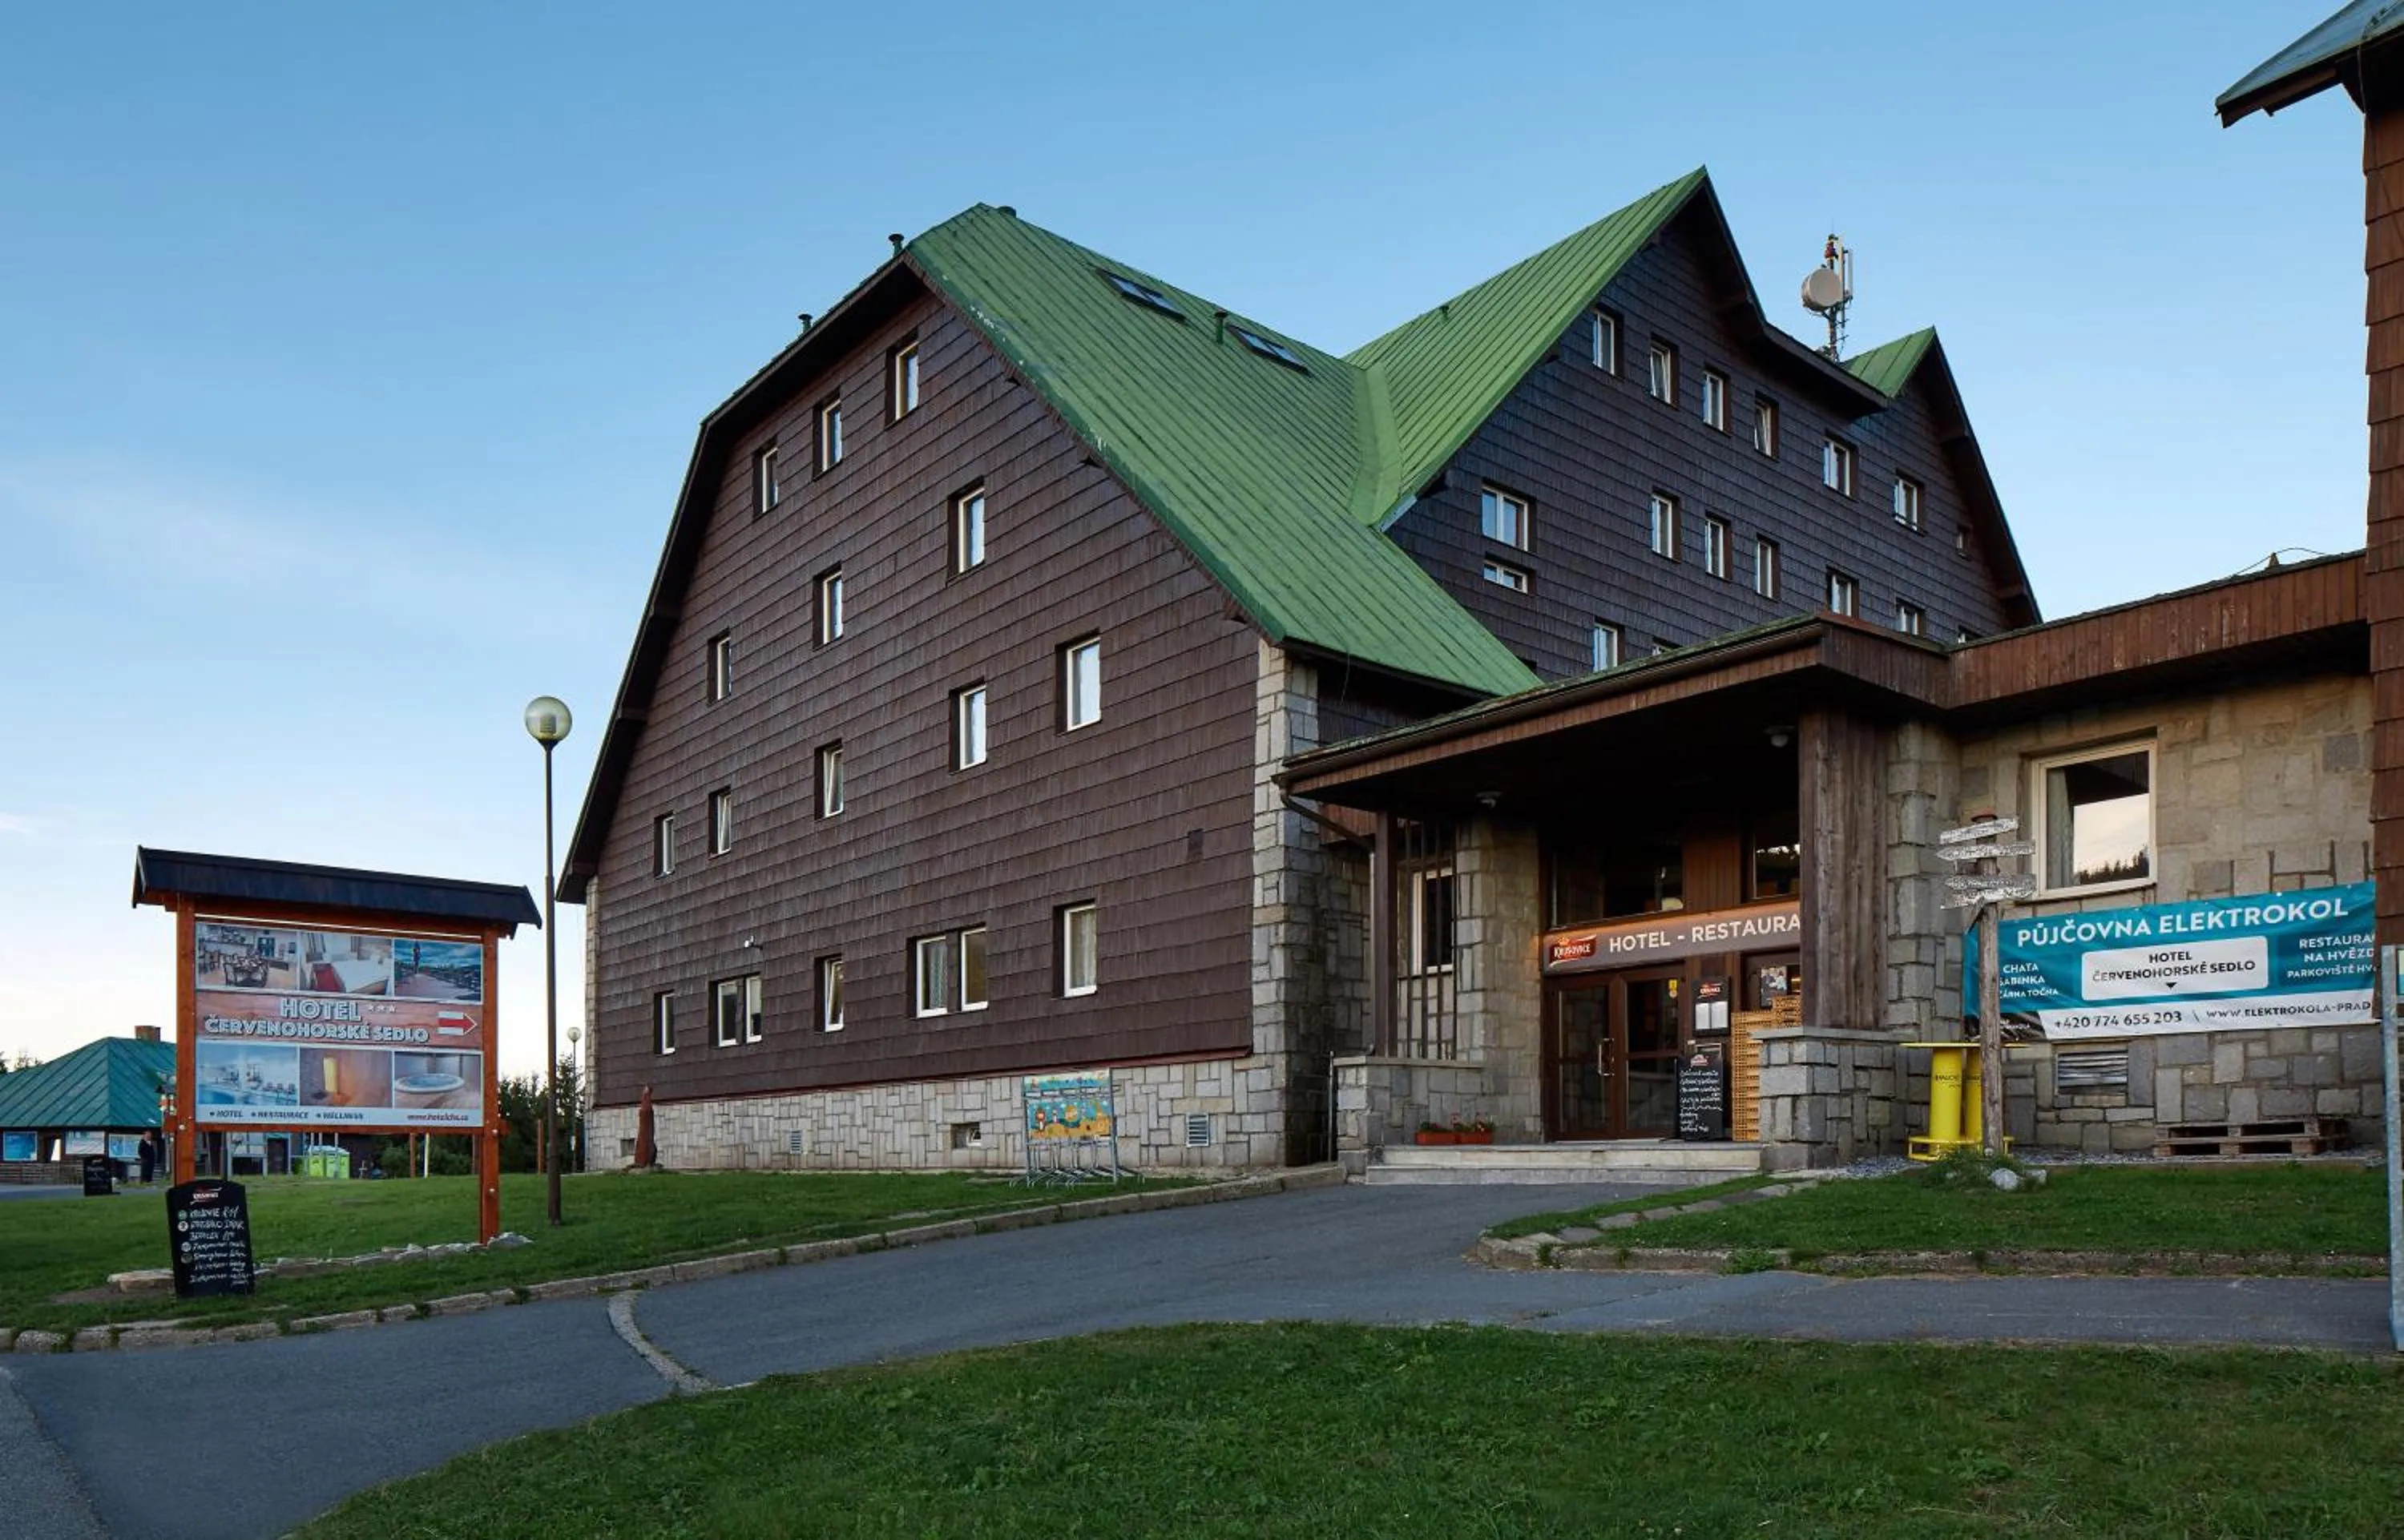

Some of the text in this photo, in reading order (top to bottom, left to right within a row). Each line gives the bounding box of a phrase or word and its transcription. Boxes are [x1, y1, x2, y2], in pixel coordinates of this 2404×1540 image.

[2017, 897, 2349, 948] PŮJČOVNA ELEKTROKOL
[1609, 931, 1671, 953] HOTEL
[1692, 913, 1801, 942] RESTAURA
[2299, 933, 2375, 949] RESTAURA
[2148, 951, 2192, 963] HOTEL
[2304, 953, 2325, 962] NA
[2003, 962, 2039, 974] CHATA
[2092, 960, 2256, 982] ČERVENOHORSKÉ SEDLO
[2287, 964, 2355, 978] PARKOVIŠTĚ
[280, 998, 362, 1021] HOTEL
[204, 1013, 430, 1043] ČERVENOHORSKÉ SEDLO
[2054, 1016, 2091, 1029] +420
[2095, 1014, 2120, 1026] 774
[2124, 1013, 2150, 1026] 655
[2153, 1011, 2182, 1024] 203
[216, 1110, 244, 1119] HOTEL
